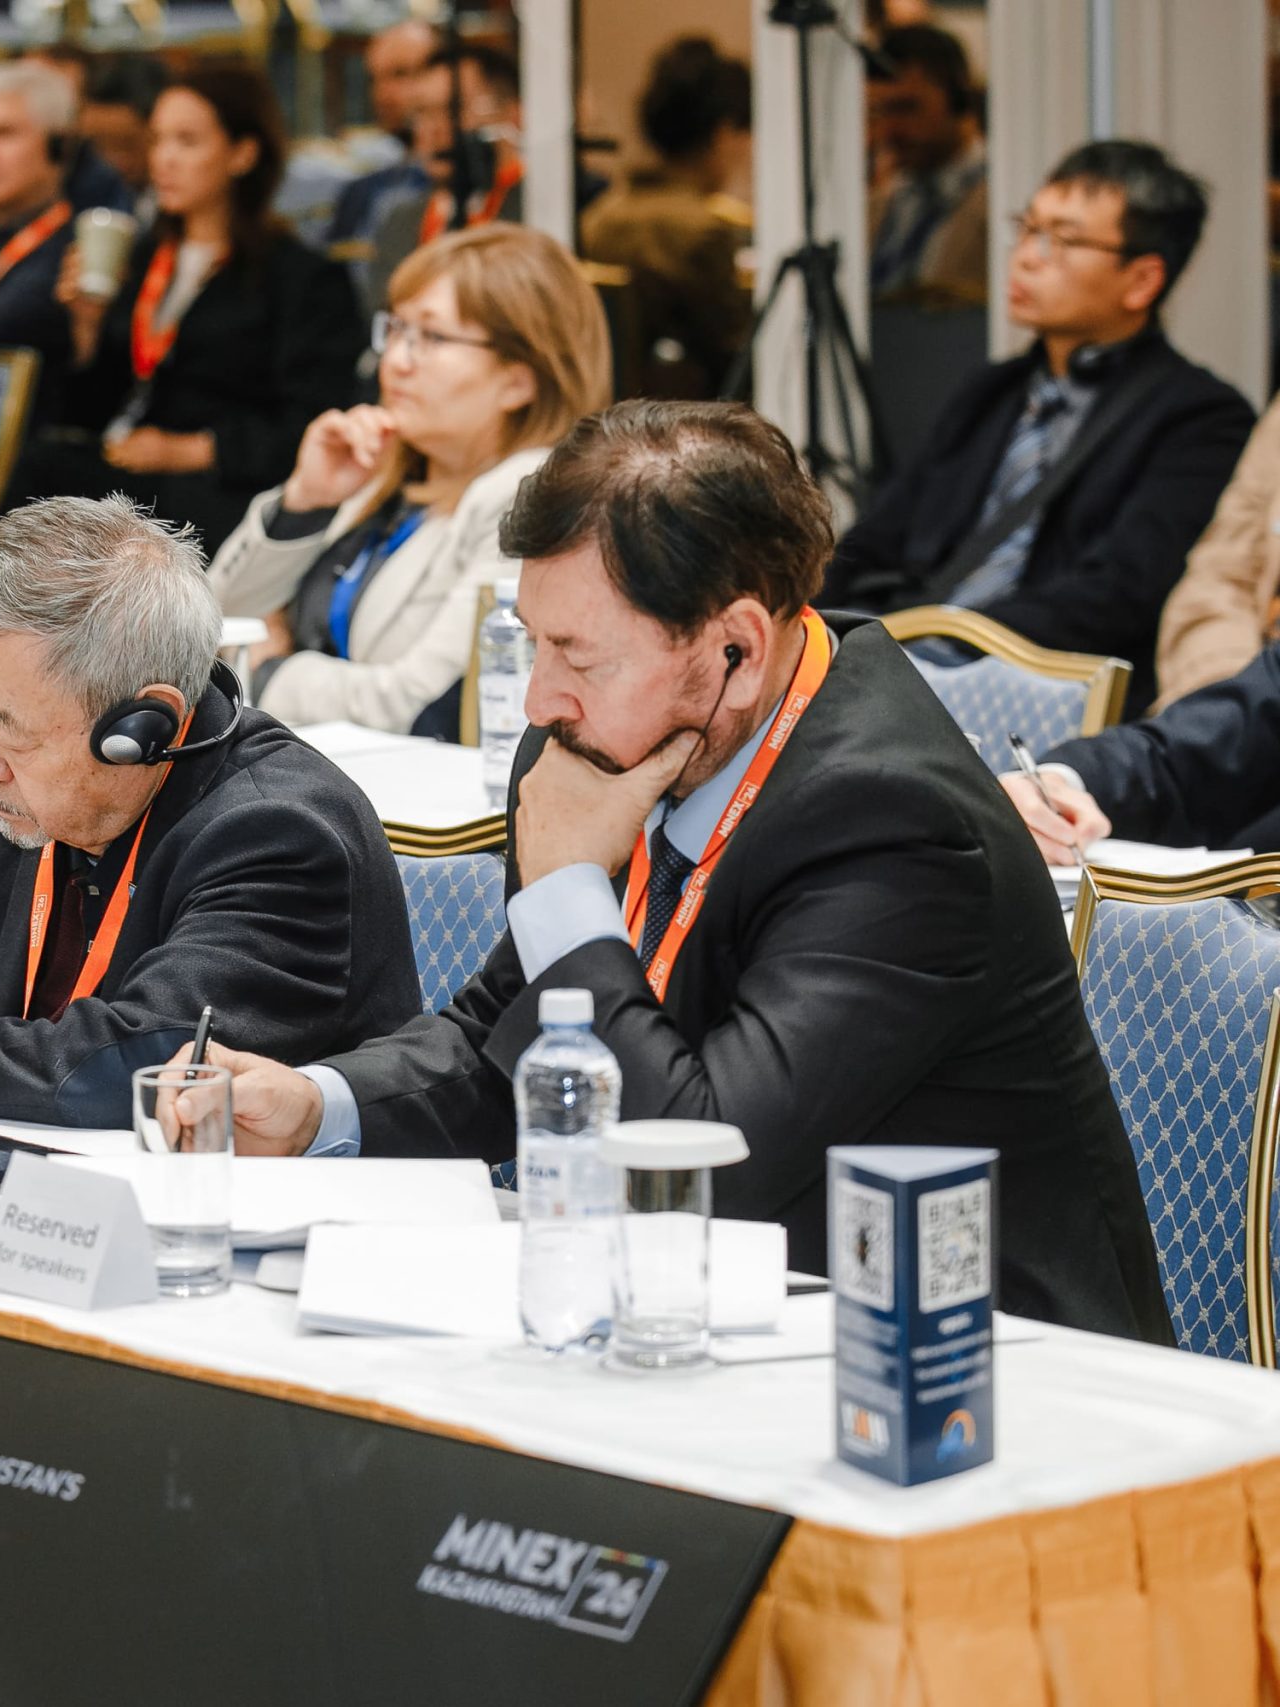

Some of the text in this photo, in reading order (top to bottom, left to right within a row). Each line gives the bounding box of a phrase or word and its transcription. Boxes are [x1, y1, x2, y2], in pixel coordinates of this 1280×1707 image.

[768, 711, 795, 751] MINEX
[717, 800, 745, 838] MINEX
[675, 887, 697, 926] MINEX
[1, 1203, 100, 1248] Reserved
[19, 1251, 88, 1284] speakers
[433, 1511, 589, 1590] MINEX
